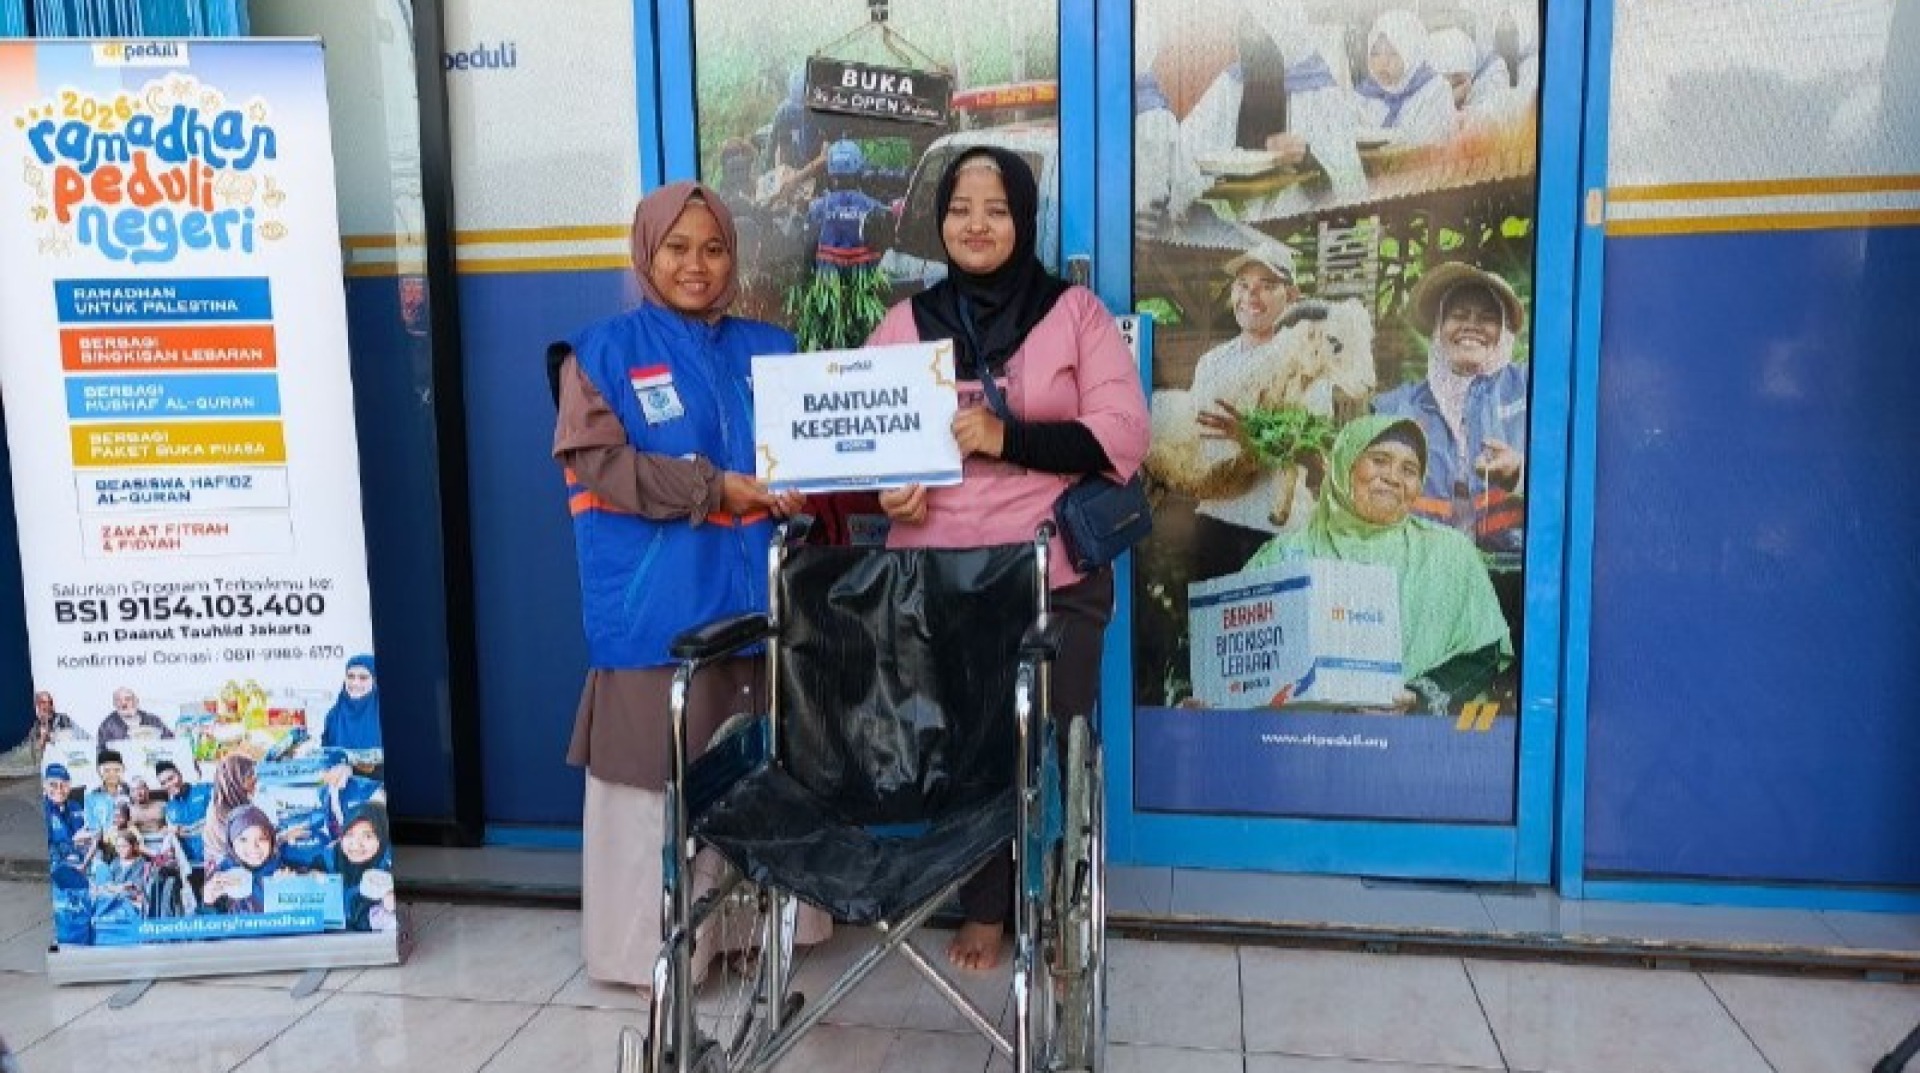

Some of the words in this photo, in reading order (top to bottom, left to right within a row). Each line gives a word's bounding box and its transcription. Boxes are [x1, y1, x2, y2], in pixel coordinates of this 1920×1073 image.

[842, 68, 913, 96] BUKA
[62, 91, 133, 130] 2026
[851, 92, 899, 113] OPEN
[28, 105, 277, 173] ramadhan
[53, 151, 214, 223] peduli
[78, 206, 255, 264] negeri
[73, 287, 176, 300] RAMADHAN
[75, 302, 138, 315] UNTUK
[143, 299, 239, 313] PALESTINA
[79, 337, 159, 350] BERBAGI
[80, 351, 178, 364] BINGKISAN
[183, 348, 263, 362] LEBARAN
[84, 384, 164, 398] BERBAGI
[803, 386, 909, 414] BANTUAN
[791, 412, 921, 440] KESEHATAN
[89, 431, 169, 444] BERBAGI
[90, 445, 151, 459] PAKET
[155, 443, 205, 456] BUKA
[211, 441, 266, 455] PUASA
[95, 478, 186, 492] BEASISWA
[190, 474, 253, 489] HAFIDZ
[97, 490, 191, 505] AL-QURAN
[102, 524, 158, 539] ZAKAT
[164, 522, 229, 537] FITRAH
[52, 582, 128, 597] Salurkan
[55, 599, 109, 624] BSI
[118, 592, 326, 622] 9154.103.400
[248, 621, 311, 637] Jakarta
[1216, 624, 1284, 657] BINGKISAN
[1221, 650, 1281, 678] LEBARAN
[1261, 730, 1389, 748] www.dtpeduli.org
